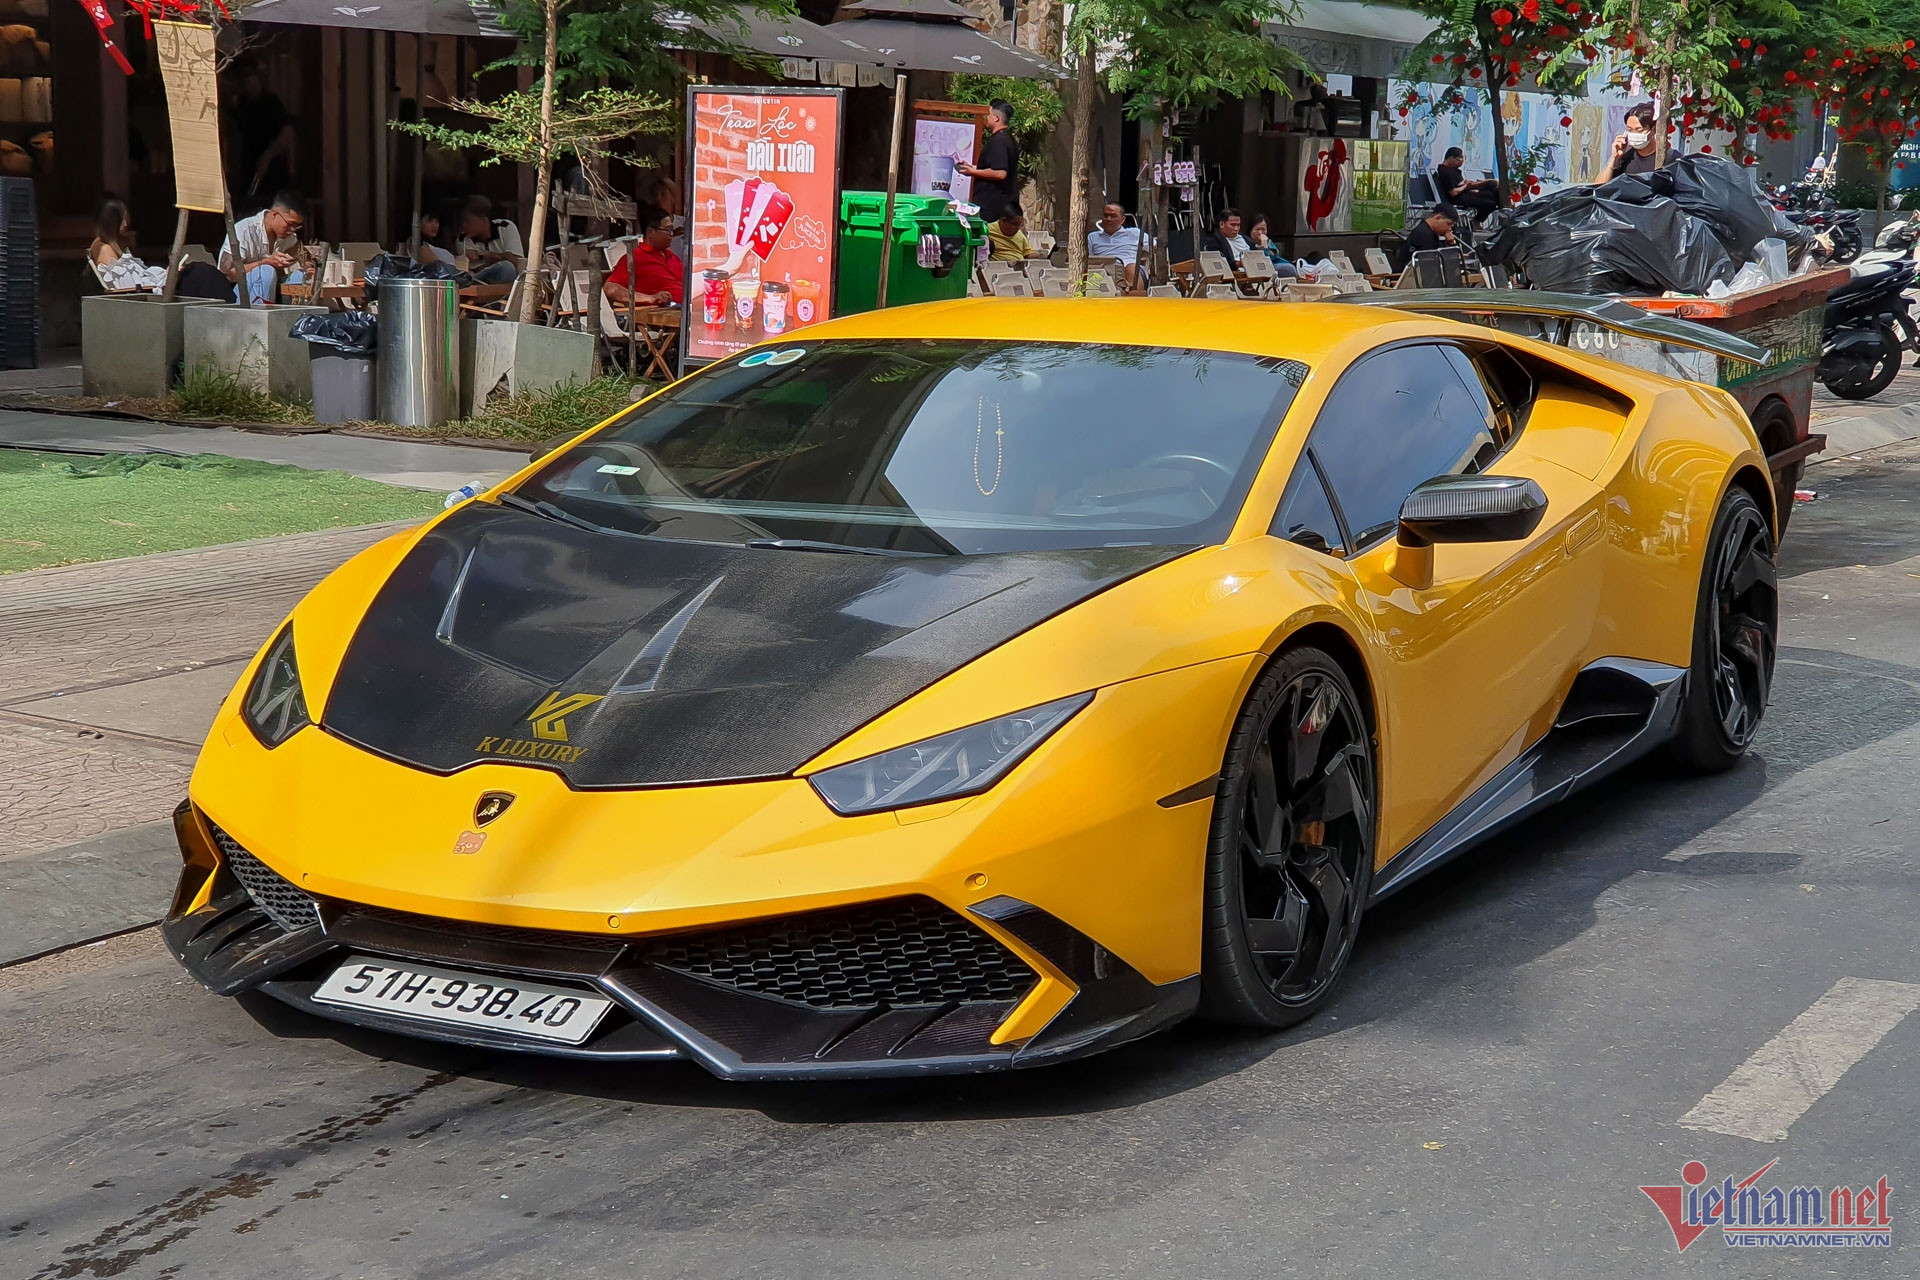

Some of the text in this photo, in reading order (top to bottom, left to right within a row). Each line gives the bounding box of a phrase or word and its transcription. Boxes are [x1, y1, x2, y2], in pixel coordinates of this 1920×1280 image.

[717, 104, 757, 137] Trao
[475, 736, 589, 763] K LUXURY
[343, 965, 583, 1028] 51H-938.40
